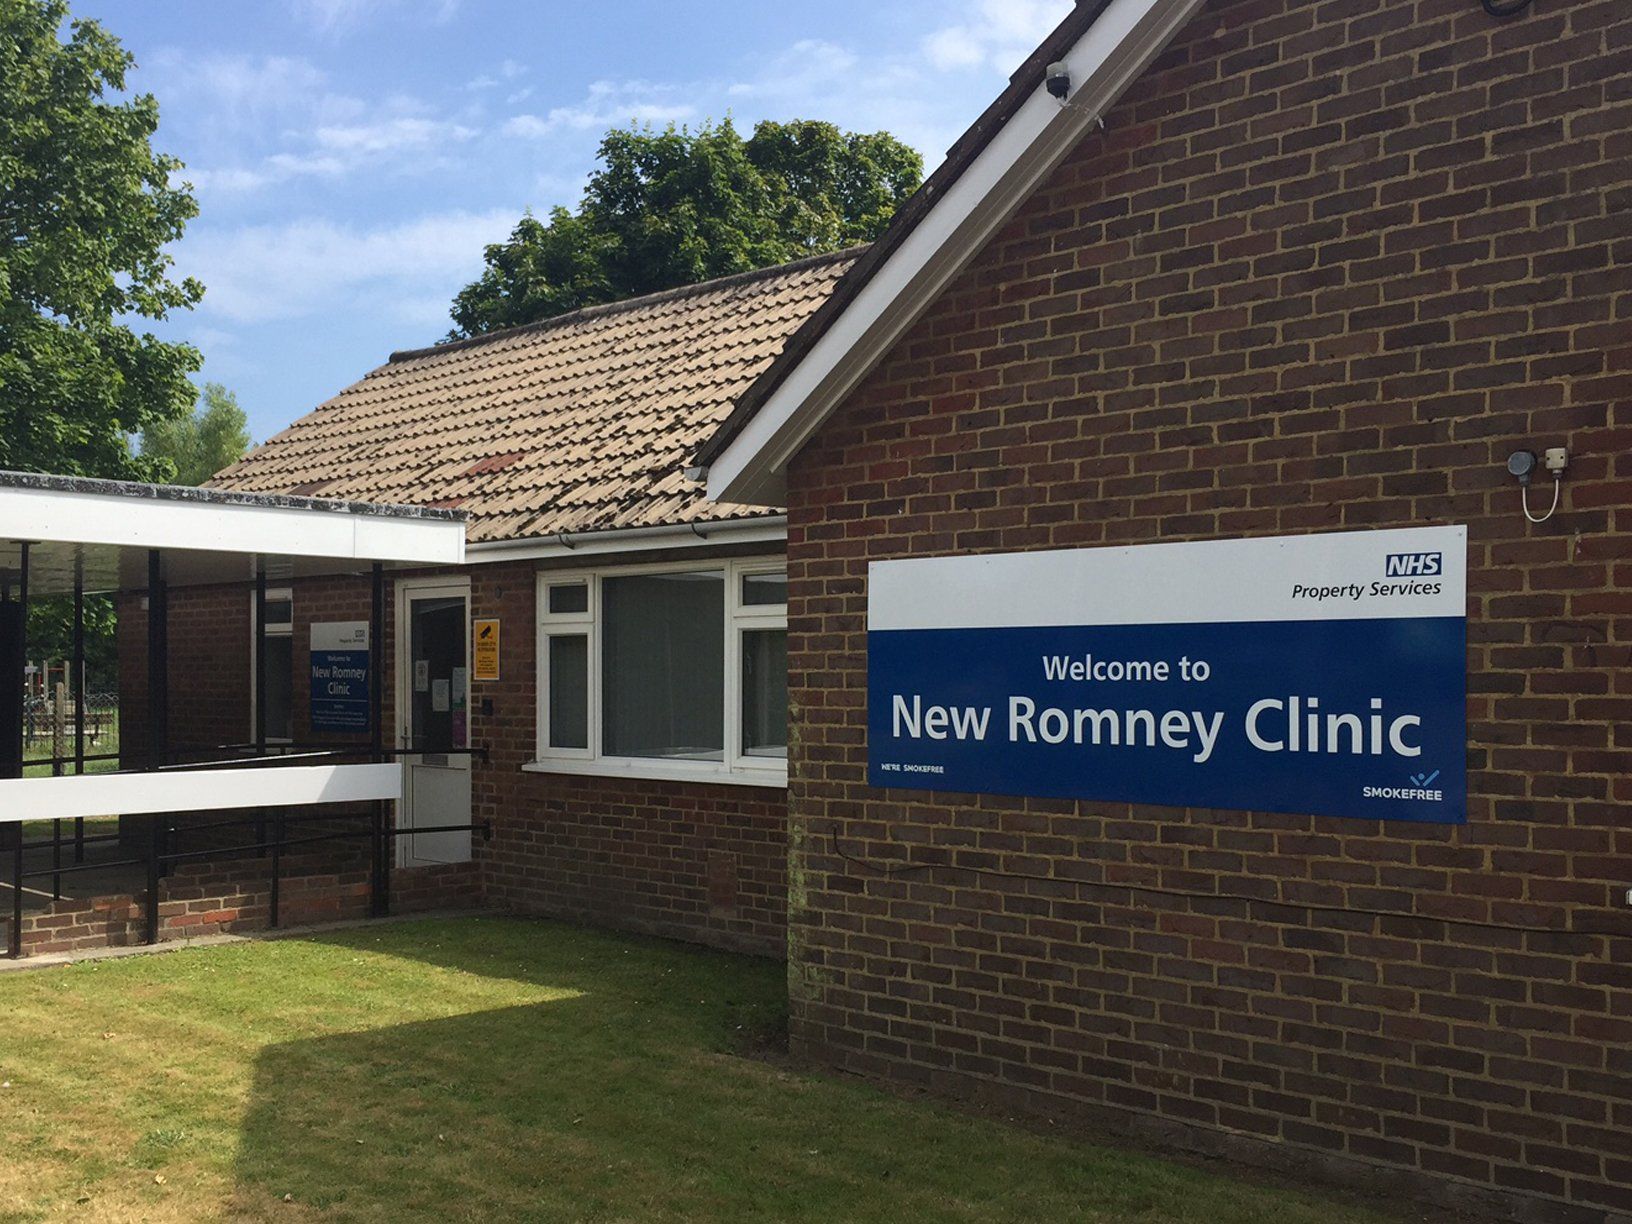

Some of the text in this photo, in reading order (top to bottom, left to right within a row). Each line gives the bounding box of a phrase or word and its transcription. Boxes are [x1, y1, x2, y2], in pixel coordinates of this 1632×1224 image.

[1387, 553, 1441, 576] NHS
[1293, 580, 1441, 600] Property Services
[312, 665, 366, 682] New Romney
[1043, 655, 1210, 681] Welcome to
[328, 682, 351, 695] Clinic
[892, 695, 1421, 762] New Romney Clinic
[881, 763, 944, 773] WE'RE SMOKEFREE
[1363, 786, 1442, 801] SMOKEFREE
